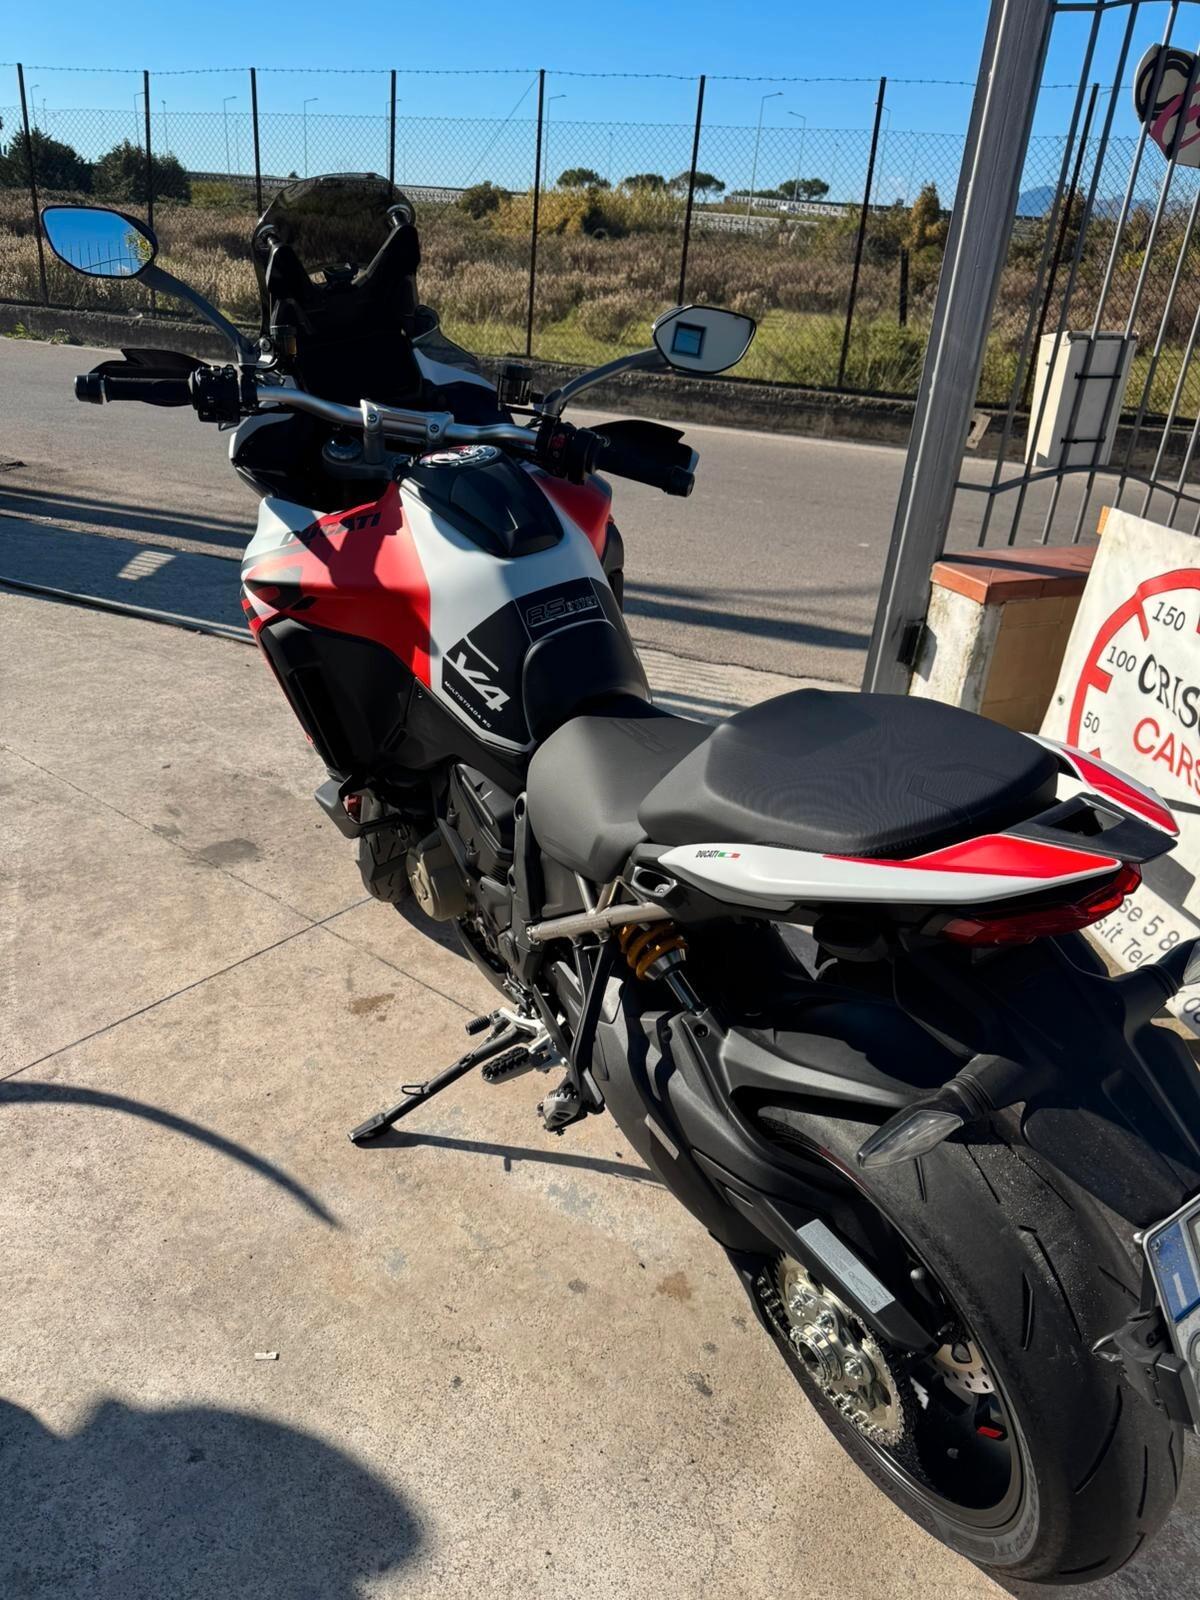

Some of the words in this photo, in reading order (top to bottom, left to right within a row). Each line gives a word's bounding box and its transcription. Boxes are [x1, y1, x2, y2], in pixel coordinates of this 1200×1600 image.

[280, 511, 382, 547] DUCATI
[1152, 601, 1186, 631] 150
[1106, 645, 1137, 672] 100
[455, 651, 511, 712] V4
[1138, 653, 1200, 736] CRIS
[1083, 711, 1100, 733] 50
[695, 849, 720, 858] DUCATI
